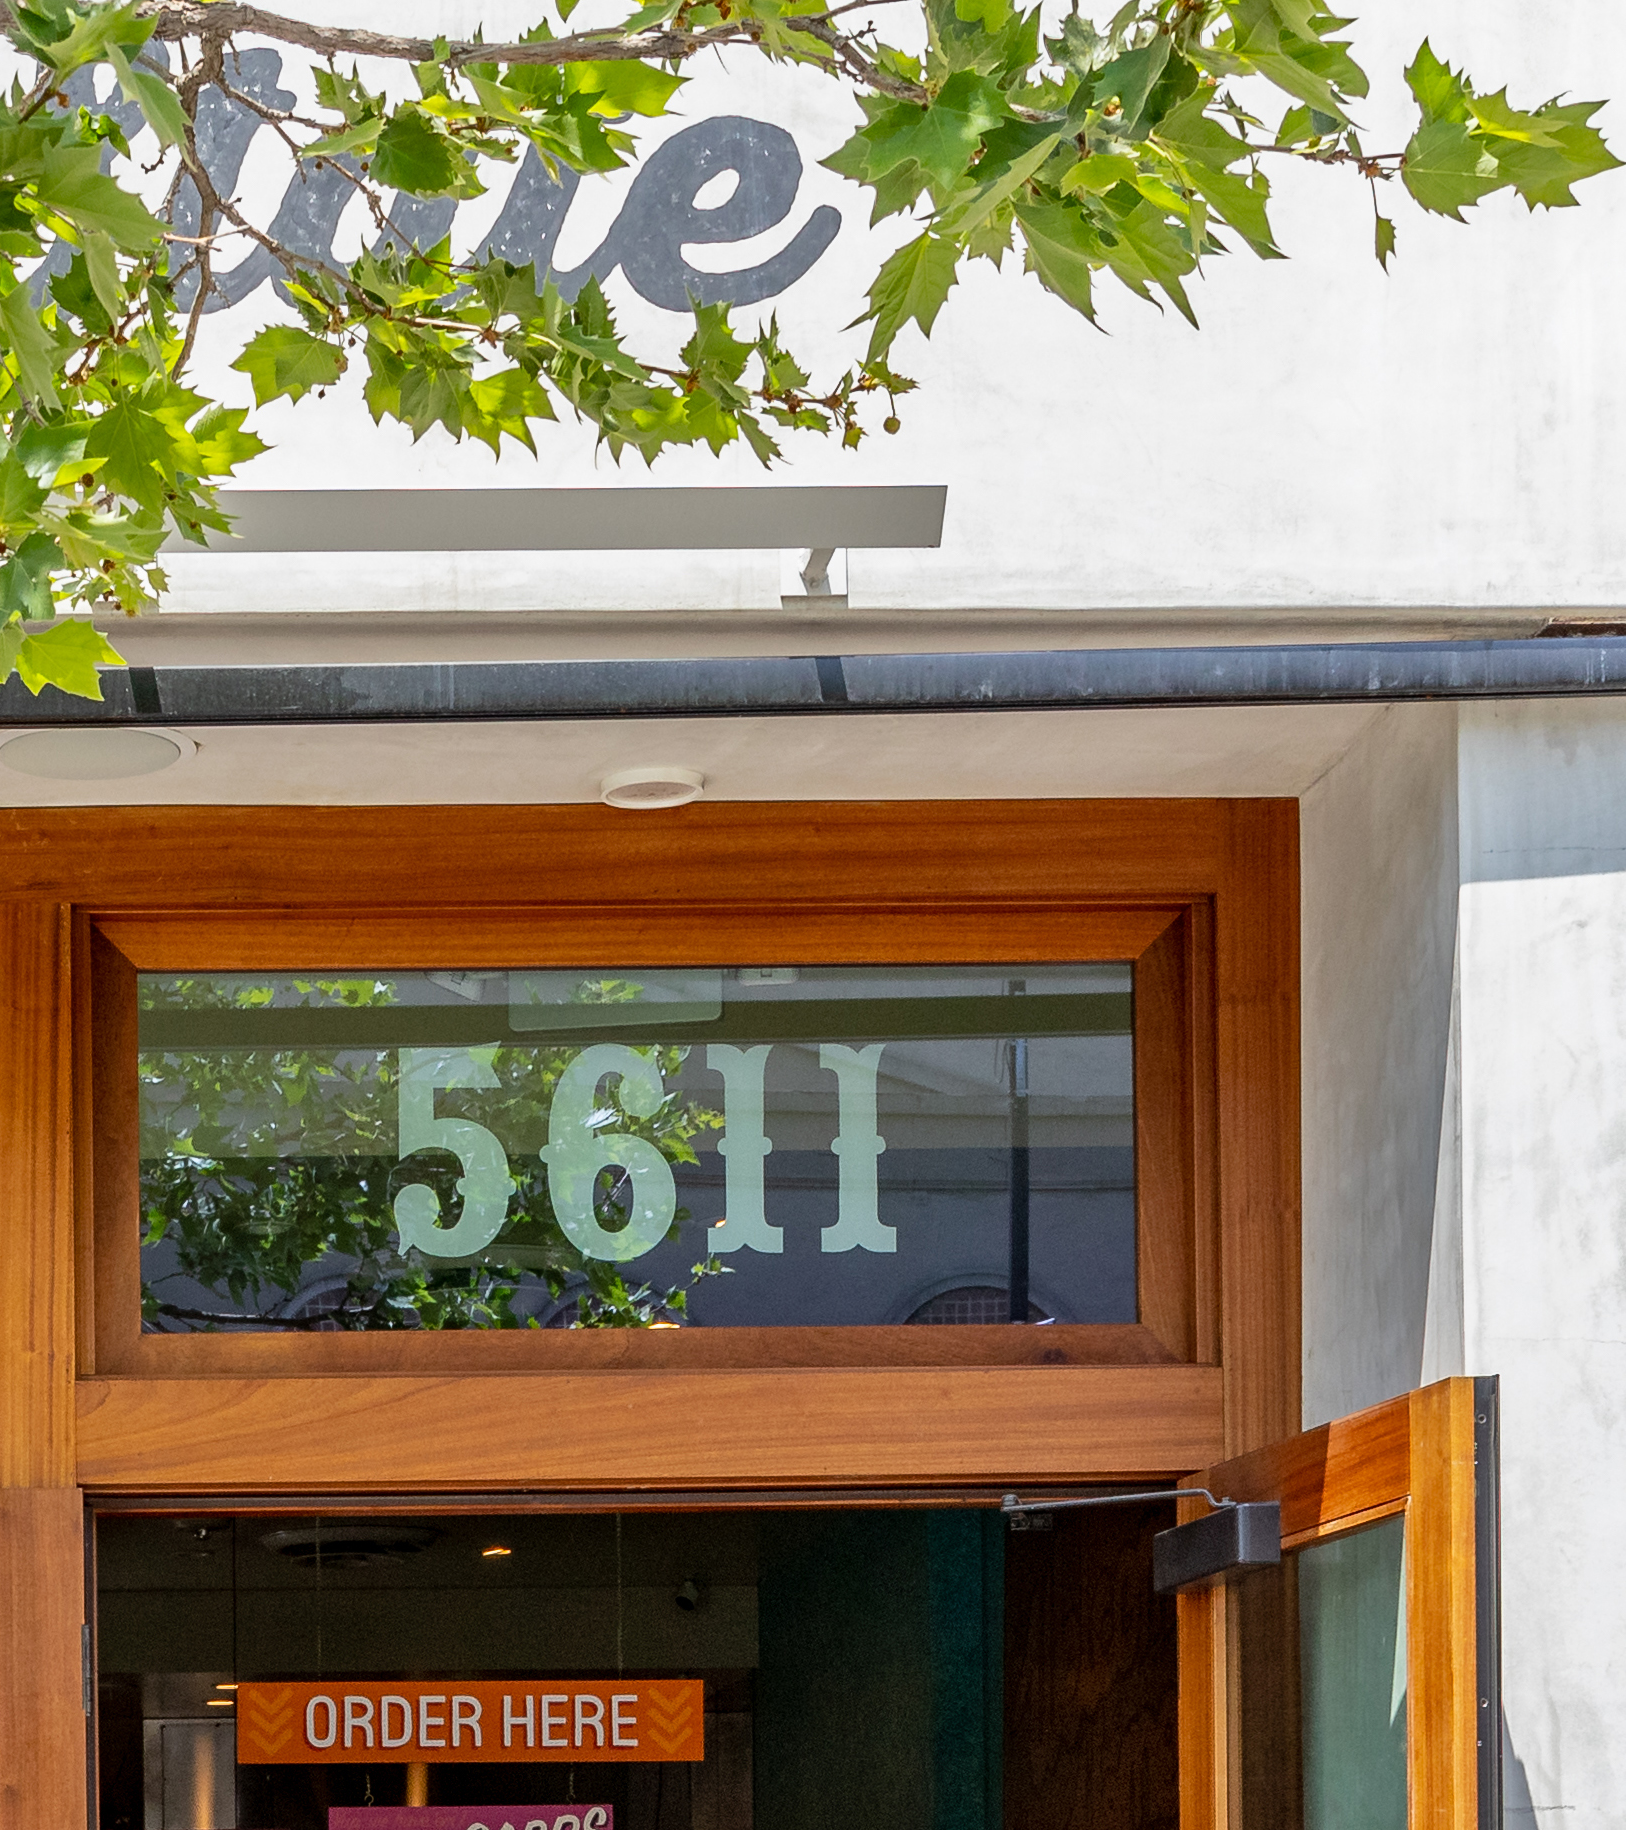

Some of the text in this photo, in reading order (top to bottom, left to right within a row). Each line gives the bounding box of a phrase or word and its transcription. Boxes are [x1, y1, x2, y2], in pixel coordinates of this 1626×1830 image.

[392, 1042, 898, 1261] 5611
[305, 1693, 639, 1749] ORDER HERE
